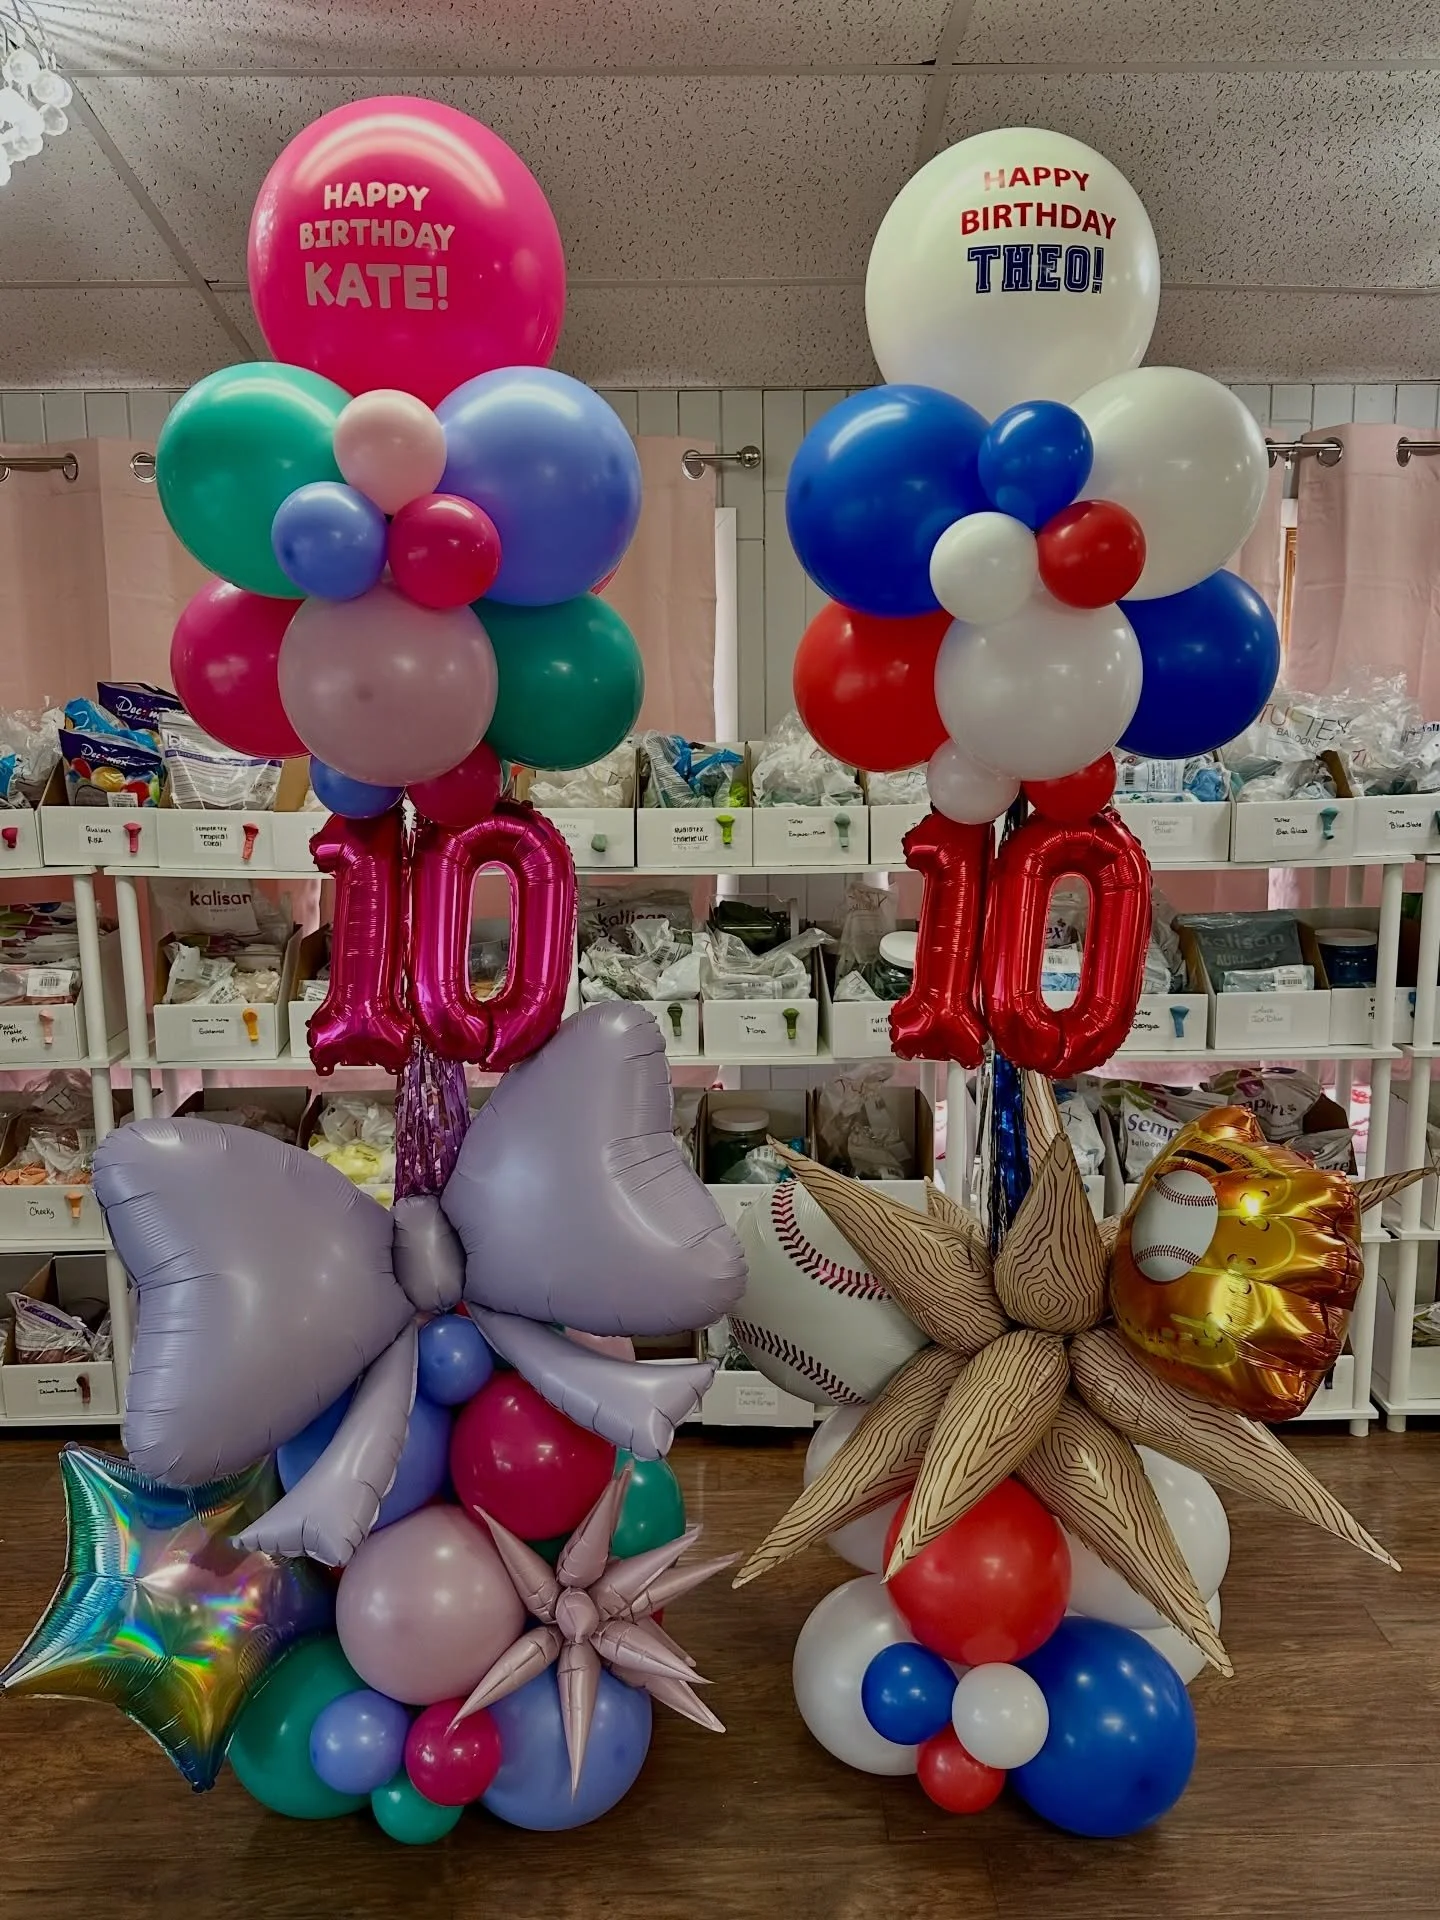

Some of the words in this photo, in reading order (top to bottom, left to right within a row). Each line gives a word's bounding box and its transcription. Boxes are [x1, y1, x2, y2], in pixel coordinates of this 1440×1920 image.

[983, 166, 1090, 191] HAPPY
[323, 182, 430, 211] HAPPY
[299, 219, 456, 251] BIRTHDAY
[961, 202, 1117, 240] BIRTHDAY
[967, 244, 1104, 294] THEO!
[304, 261, 449, 311] KATE!
[1276, 727, 1321, 748] BAOONS
[190, 889, 252, 907] kalisan
[306, 797, 578, 1076] 10
[887, 805, 1153, 1080] 10
[1199, 932, 1285, 950] kalisan
[29, 1206, 55, 1219] Cheeky
